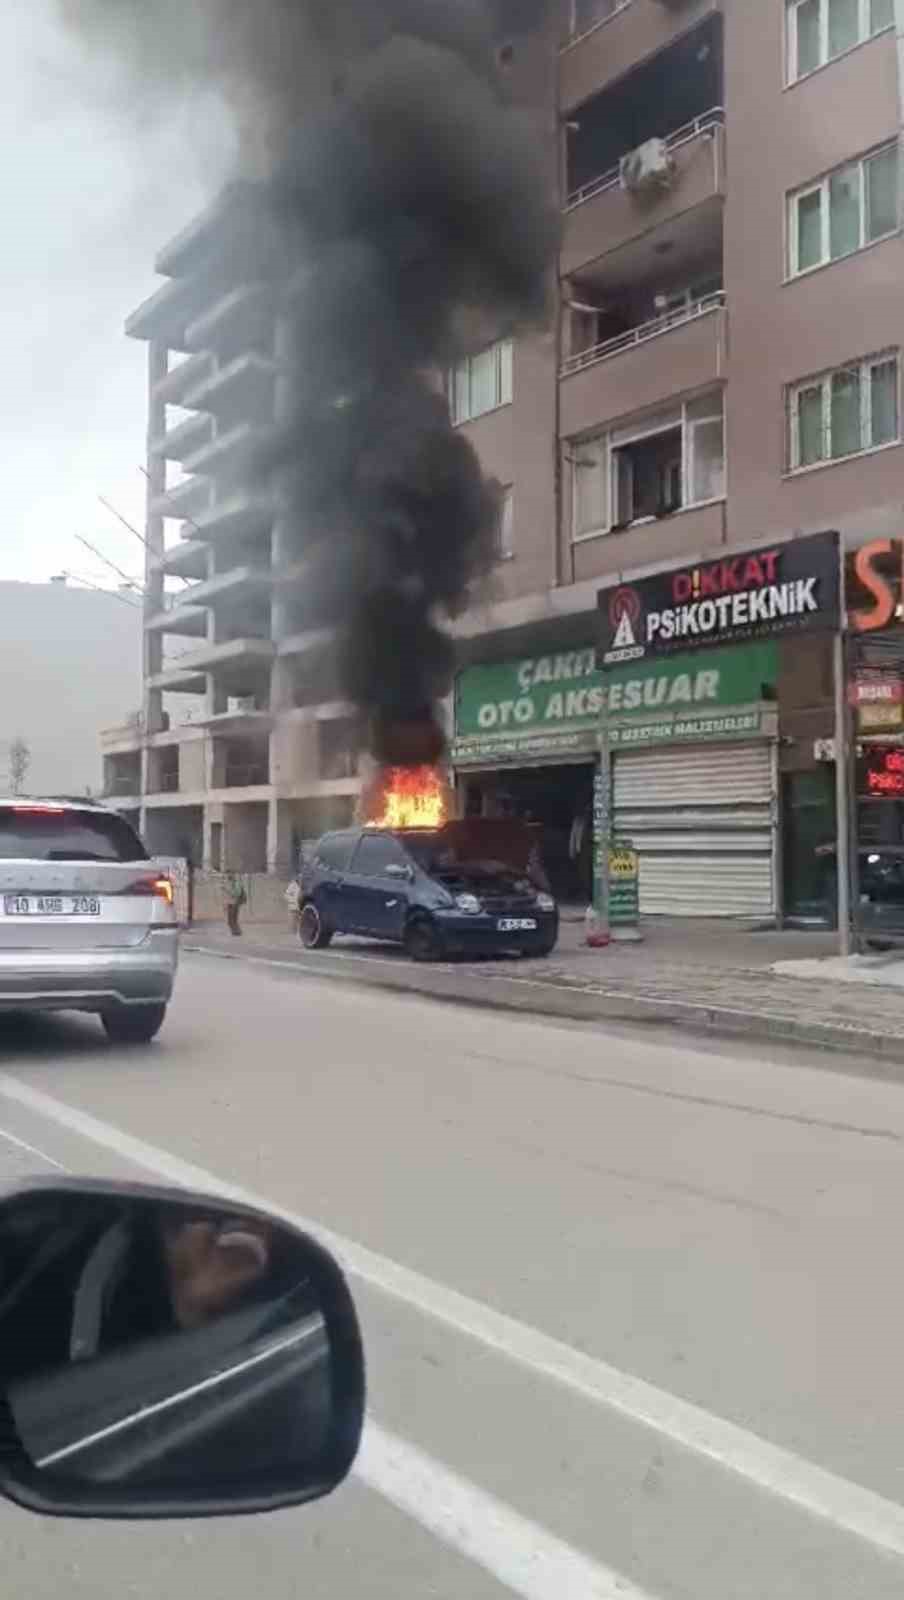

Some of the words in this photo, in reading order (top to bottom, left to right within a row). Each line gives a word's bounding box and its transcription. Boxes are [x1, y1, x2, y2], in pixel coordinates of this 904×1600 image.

[849, 537, 904, 630] S
[477, 697, 534, 728] OTO
[545, 669, 720, 719] AKSESUAR
